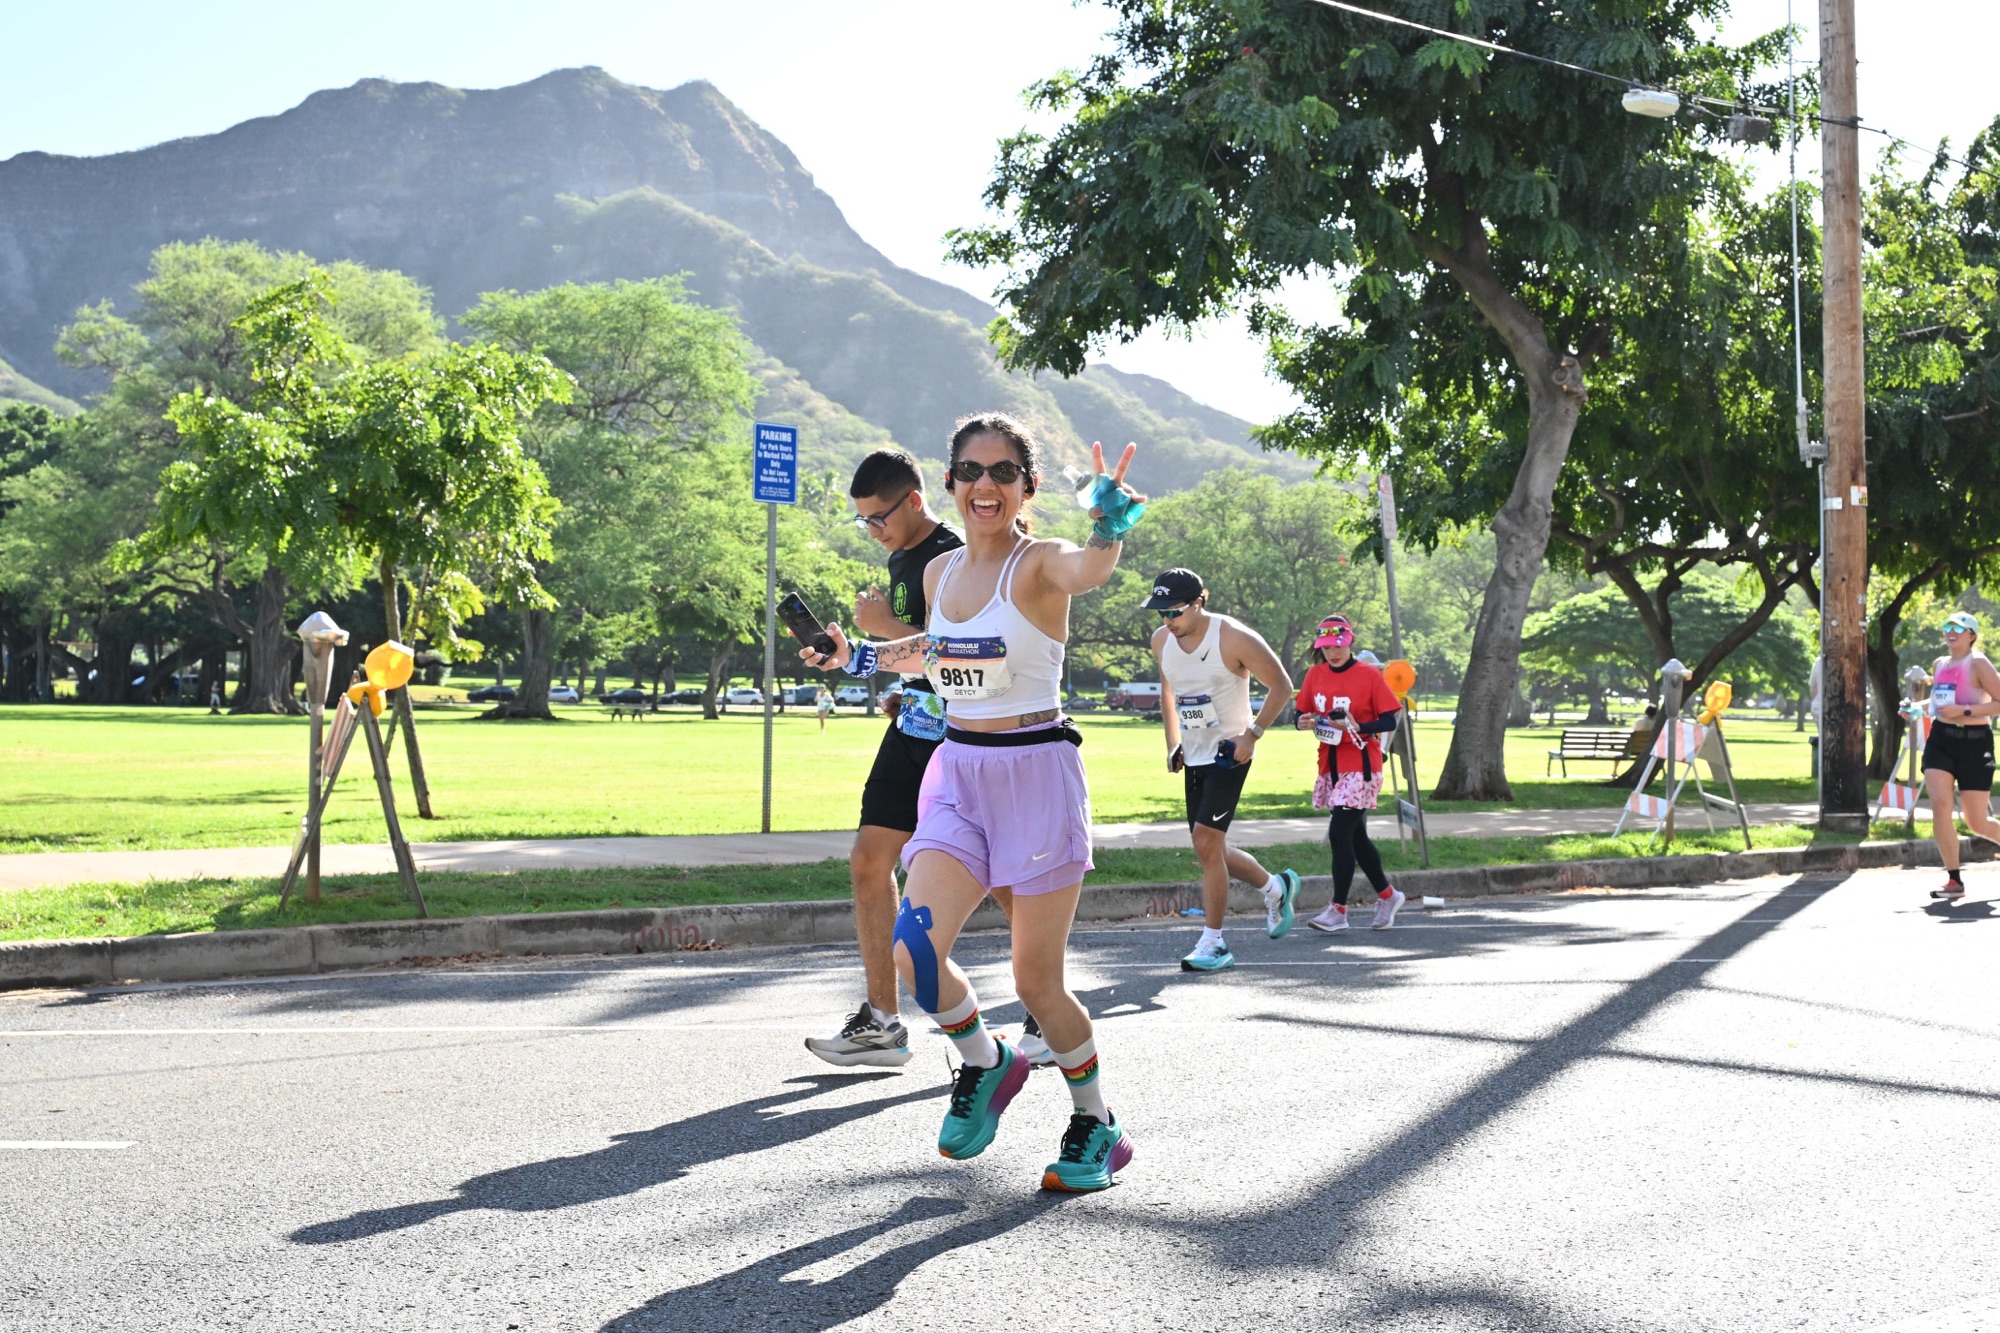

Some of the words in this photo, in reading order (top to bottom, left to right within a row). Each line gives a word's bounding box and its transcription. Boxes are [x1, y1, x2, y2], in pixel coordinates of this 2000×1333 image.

[761, 429, 792, 443] PARKING
[768, 443, 778, 451] Park
[940, 667, 984, 687] 9817
[1181, 709, 1204, 720] 9380
[1091, 1139, 1111, 1166] HOKA
